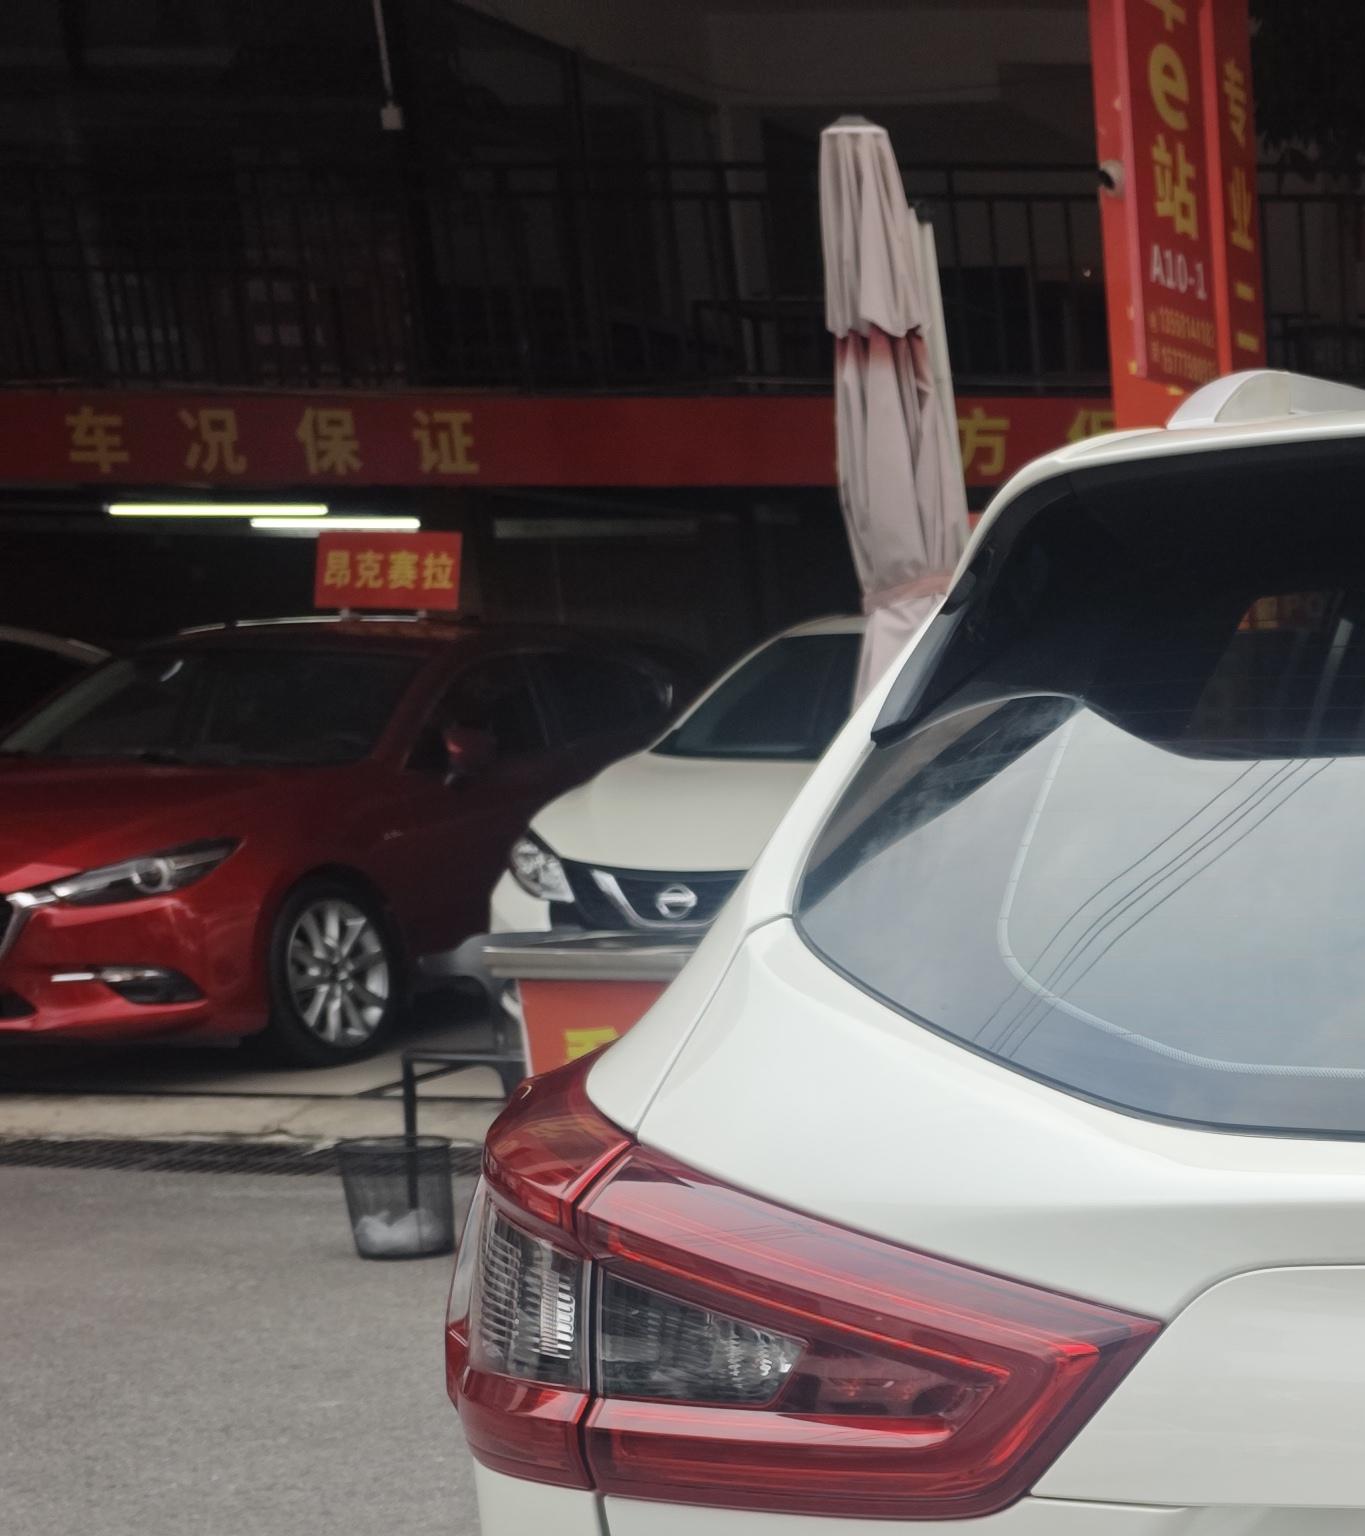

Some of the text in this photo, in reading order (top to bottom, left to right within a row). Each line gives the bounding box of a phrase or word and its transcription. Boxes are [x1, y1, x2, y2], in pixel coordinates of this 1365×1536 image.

[65, 405, 480, 475] 车况保证
[323, 549, 455, 590] 昂克赛拉
